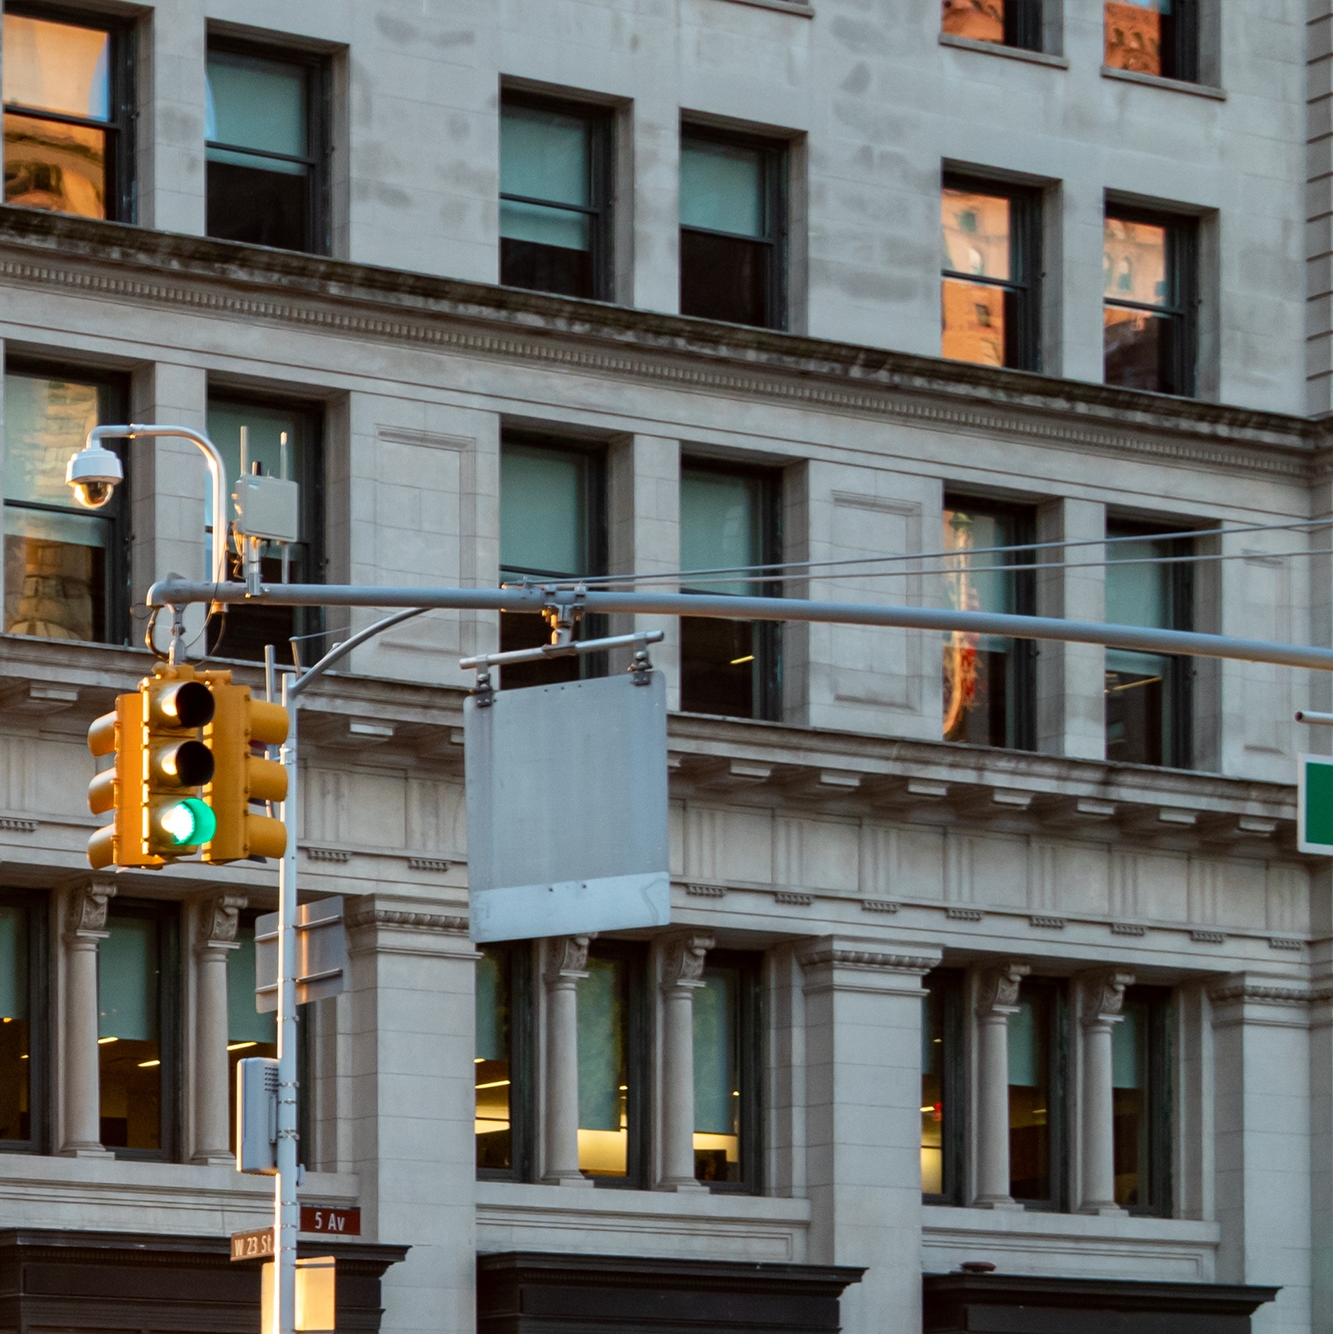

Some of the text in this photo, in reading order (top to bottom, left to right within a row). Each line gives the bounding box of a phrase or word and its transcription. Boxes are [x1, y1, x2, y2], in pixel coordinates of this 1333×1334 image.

[314, 1211, 345, 1232] 5 Av
[234, 1234, 272, 1257] W 23 St
